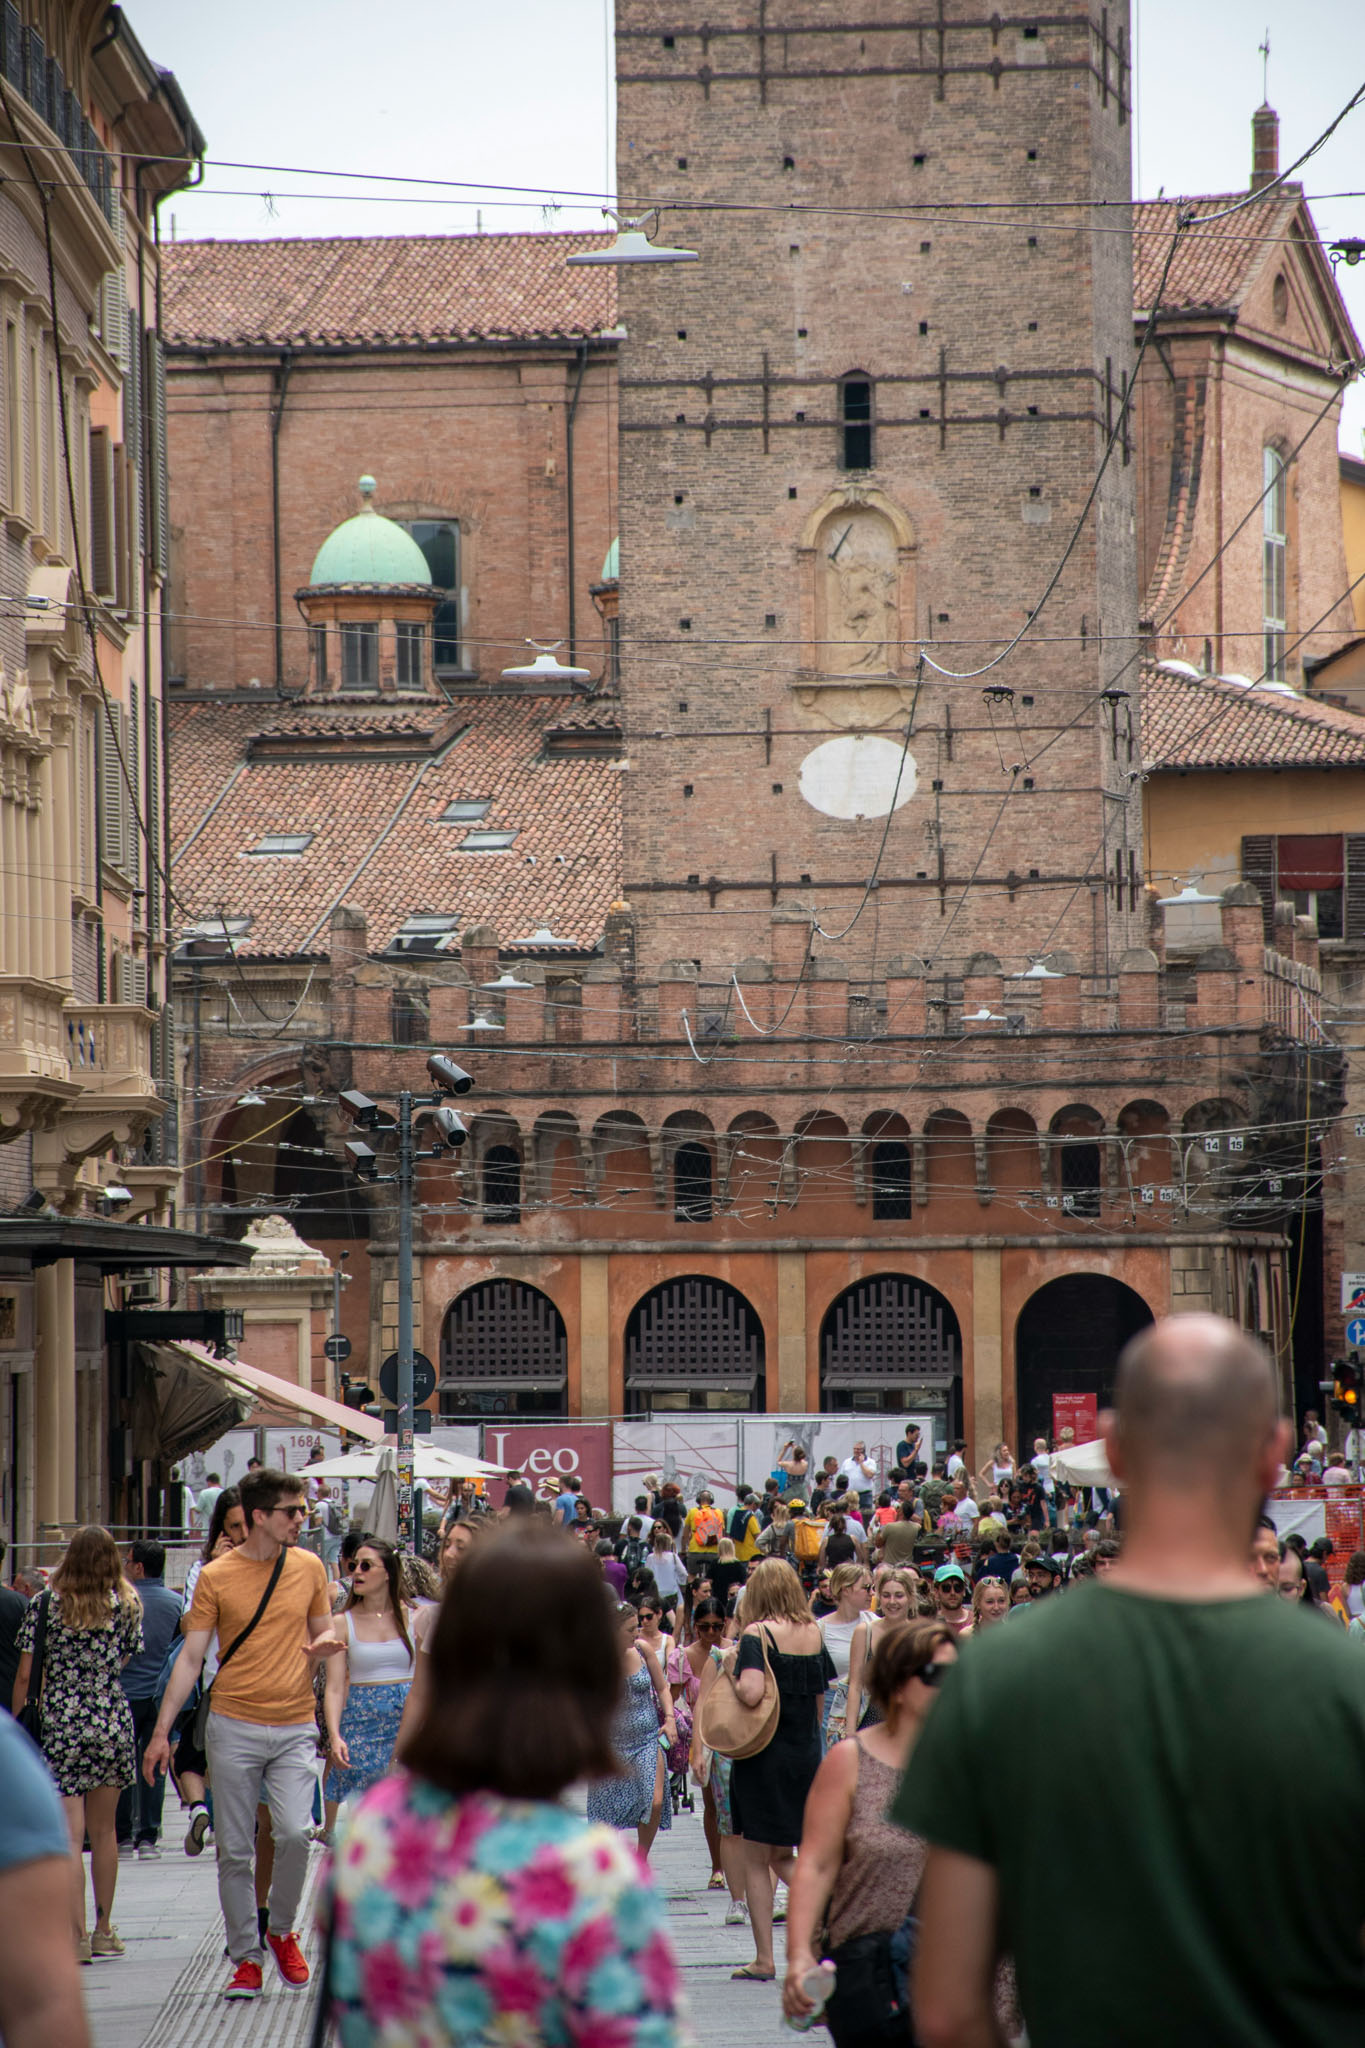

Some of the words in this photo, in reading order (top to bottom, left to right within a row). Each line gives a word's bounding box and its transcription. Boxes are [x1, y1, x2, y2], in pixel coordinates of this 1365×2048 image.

[1206, 1141, 1219, 1150] 14
[1231, 1140, 1242, 1150] 15
[1270, 1183, 1281, 1191] 13
[1161, 1192, 1171, 1200] 15
[290, 1434, 321, 1448] 1684
[491, 1432, 580, 1474] Leo
